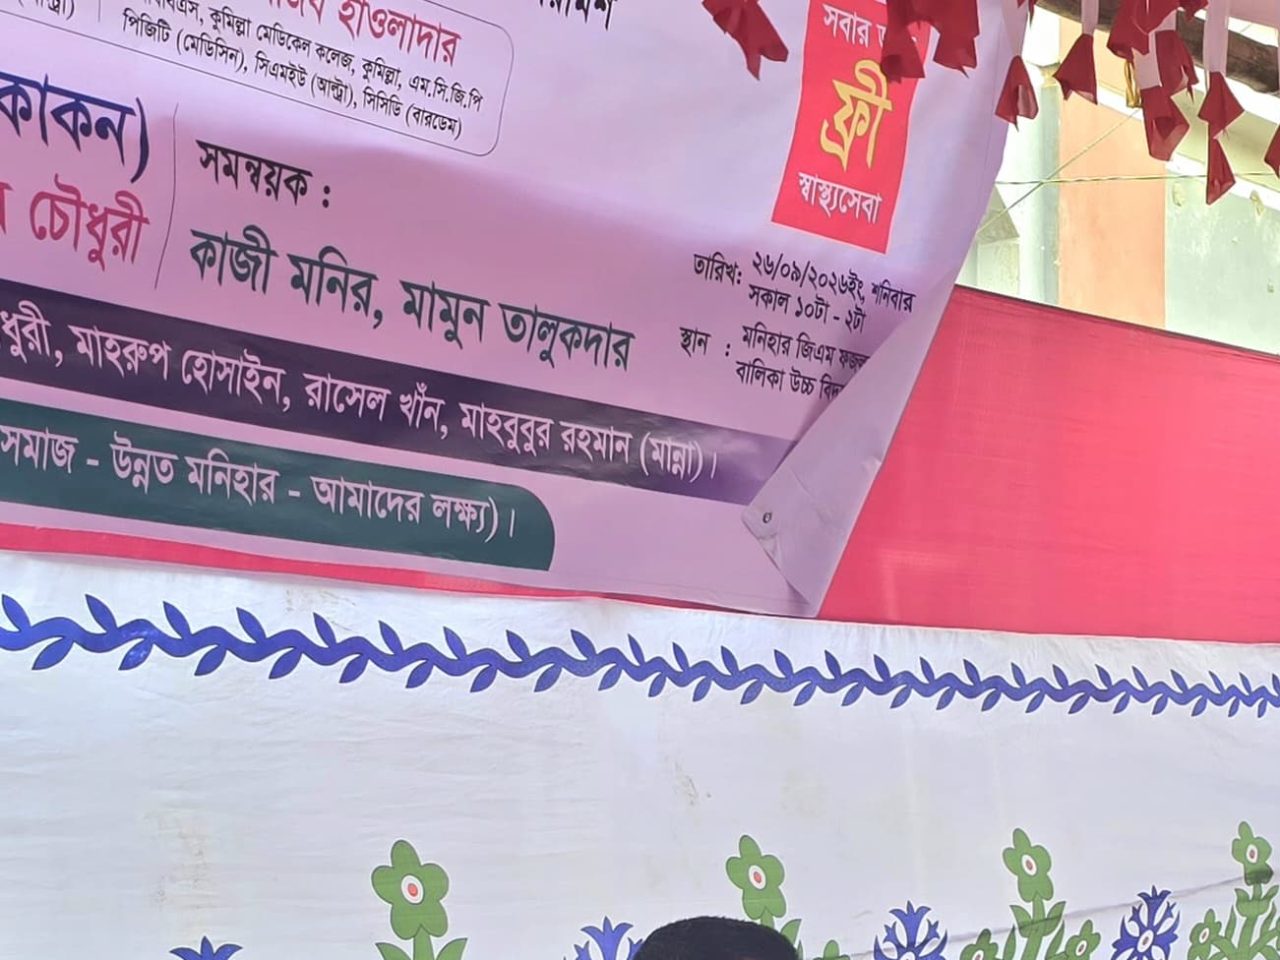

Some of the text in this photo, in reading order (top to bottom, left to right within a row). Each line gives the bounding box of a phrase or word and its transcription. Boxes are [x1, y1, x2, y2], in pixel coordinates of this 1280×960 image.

[208, 6, 252, 38] কুমিল্লা
[256, 22, 312, 57] মেডিকেল
[314, 42, 355, 75] কলেজ,
[362, 57, 402, 90] কুমিল্লা,
[822, 4, 872, 48] সবার
[122, 7, 172, 43] পিজিটি
[176, 28, 248, 74] (মেডিসিন),
[254, 50, 308, 88] সিএমইউ
[362, 86, 404, 117] সিসিডি
[405, 103, 462, 141] (বারডেম)
[195, 139, 313, 206] সমন্বয়ক
[797, 171, 883, 225] স্বাস্থ্যসেবা
[30, 173, 150, 272] চৌধুরী
[189, 225, 636, 371] কাজী মনির, মামুন তালুকদার
[693, 252, 742, 286] তারিখ:
[871, 279, 916, 313] শনিবার
[748, 283, 791, 314] সকাল
[794, 296, 830, 324] ১০টা
[844, 305, 866, 334] ২টা
[679, 326, 712, 357] স্থান
[741, 321, 793, 357] মনিহার
[796, 333, 836, 365] জিএম
[181, 348, 291, 412] হোসাইন,
[303, 373, 392, 422] রাসেল
[399, 382, 449, 440] খাঁন,
[458, 402, 555, 457] মাহবুবুর
[559, 420, 633, 464] রহমান
[735, 358, 786, 391] বালিকা
[789, 366, 817, 396] উচ্চ
[0, 425, 79, 474] সমাজ
[110, 430, 179, 494] উন্নত
[184, 447, 281, 506] মনিহার
[310, 476, 425, 524] আমাদের
